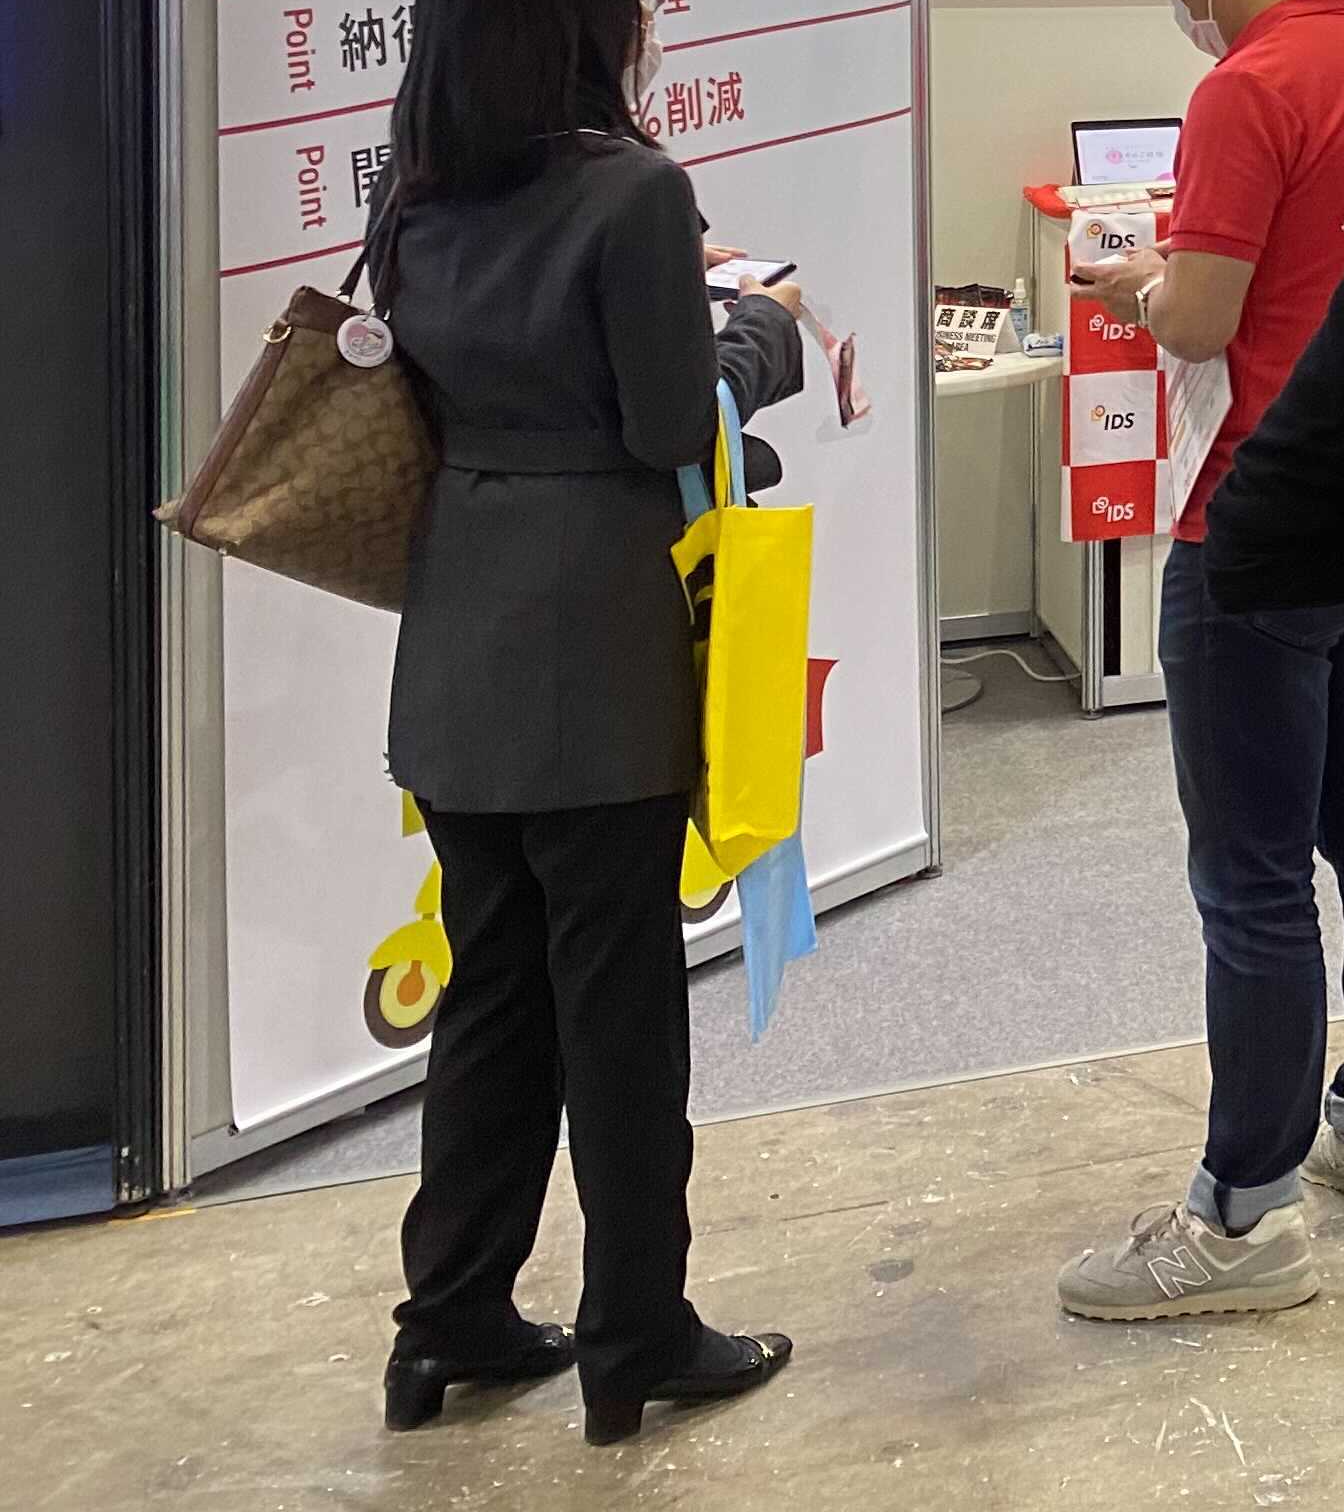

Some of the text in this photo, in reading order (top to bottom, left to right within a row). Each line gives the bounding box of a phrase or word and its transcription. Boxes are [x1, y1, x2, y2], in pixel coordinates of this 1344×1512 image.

[282, 6, 317, 95] Point
[294, 145, 328, 232] Point
[1100, 232, 1136, 250] IDS
[1102, 322, 1137, 340] IDS
[1104, 411, 1135, 431] IDS
[1106, 503, 1135, 523] IDS
